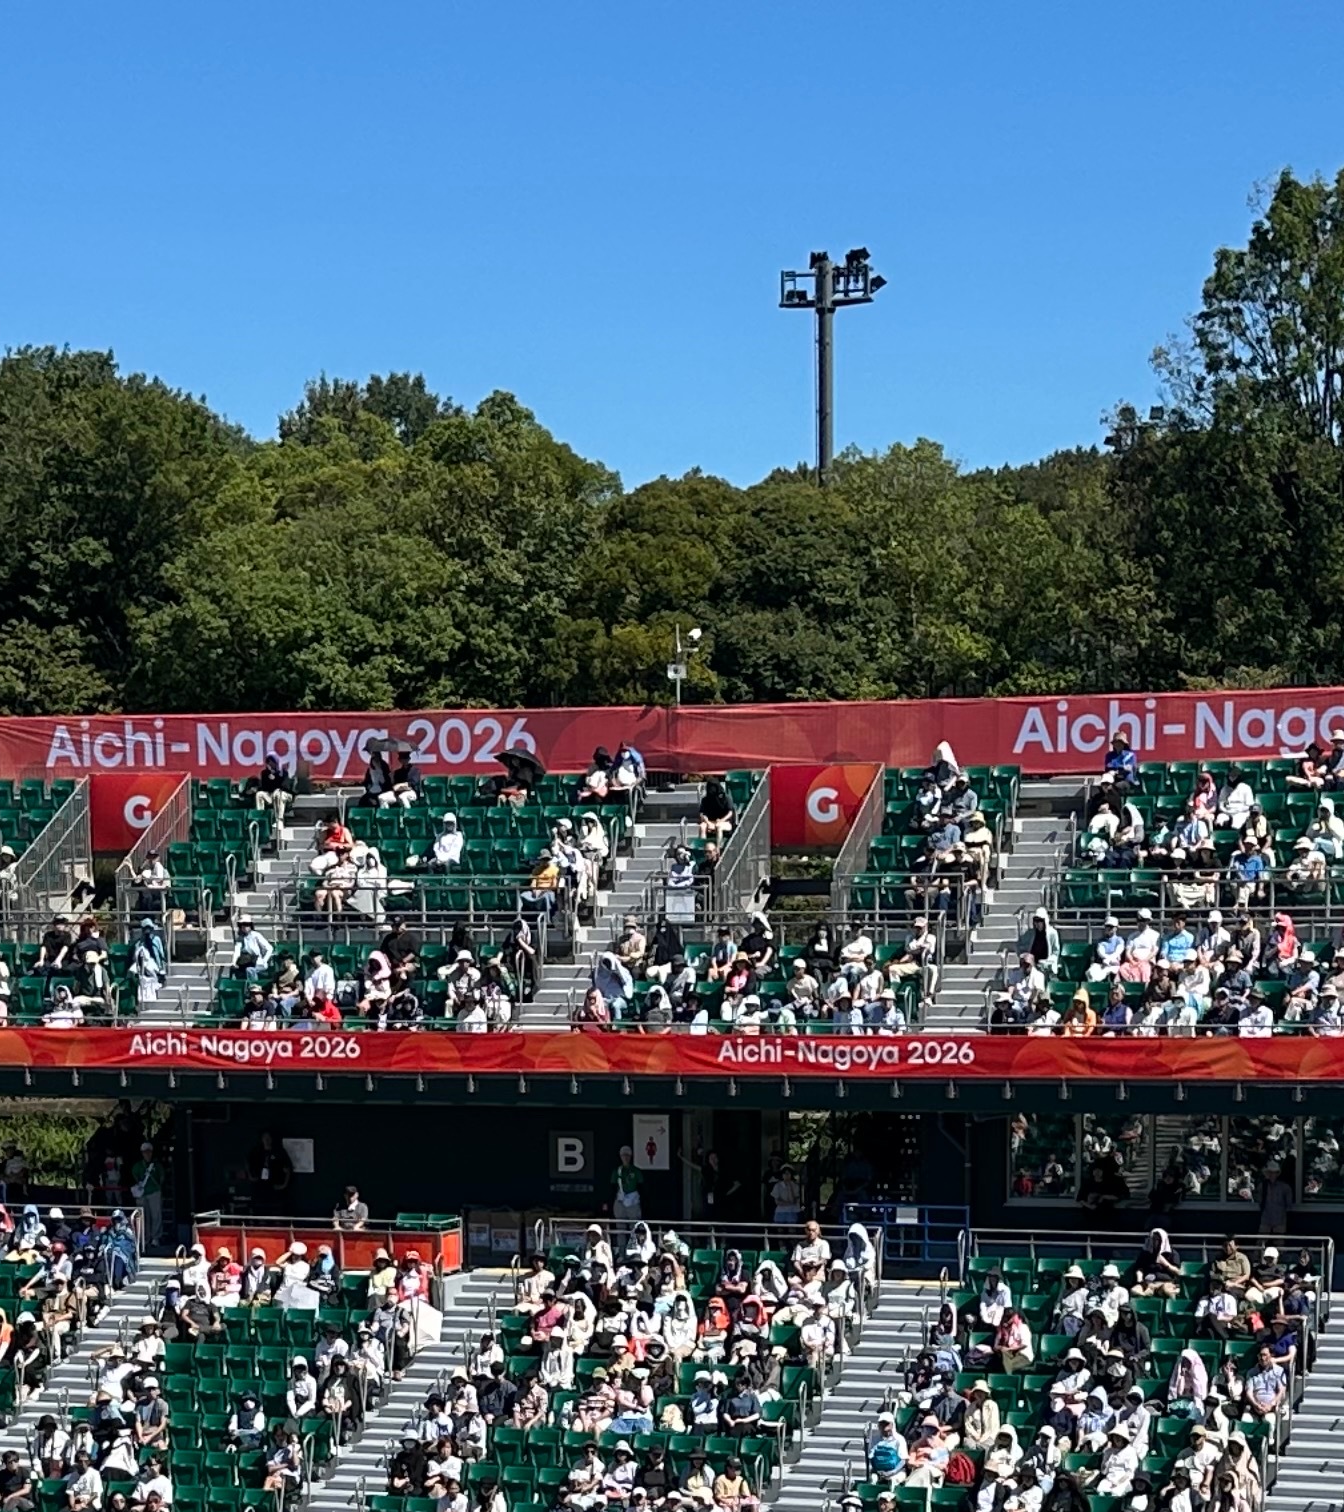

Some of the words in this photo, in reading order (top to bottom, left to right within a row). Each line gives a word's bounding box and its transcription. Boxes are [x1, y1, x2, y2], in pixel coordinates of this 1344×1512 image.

[406, 717, 536, 764] 2026
[124, 795, 152, 829] G
[807, 787, 839, 823] G
[129, 1032, 293, 1064] Aichi-Nagoya
[299, 1037, 361, 1058] 2026
[717, 1038, 899, 1070] Aichi-Nagoya
[907, 1041, 975, 1064] 2026
[557, 1137, 585, 1172] B
